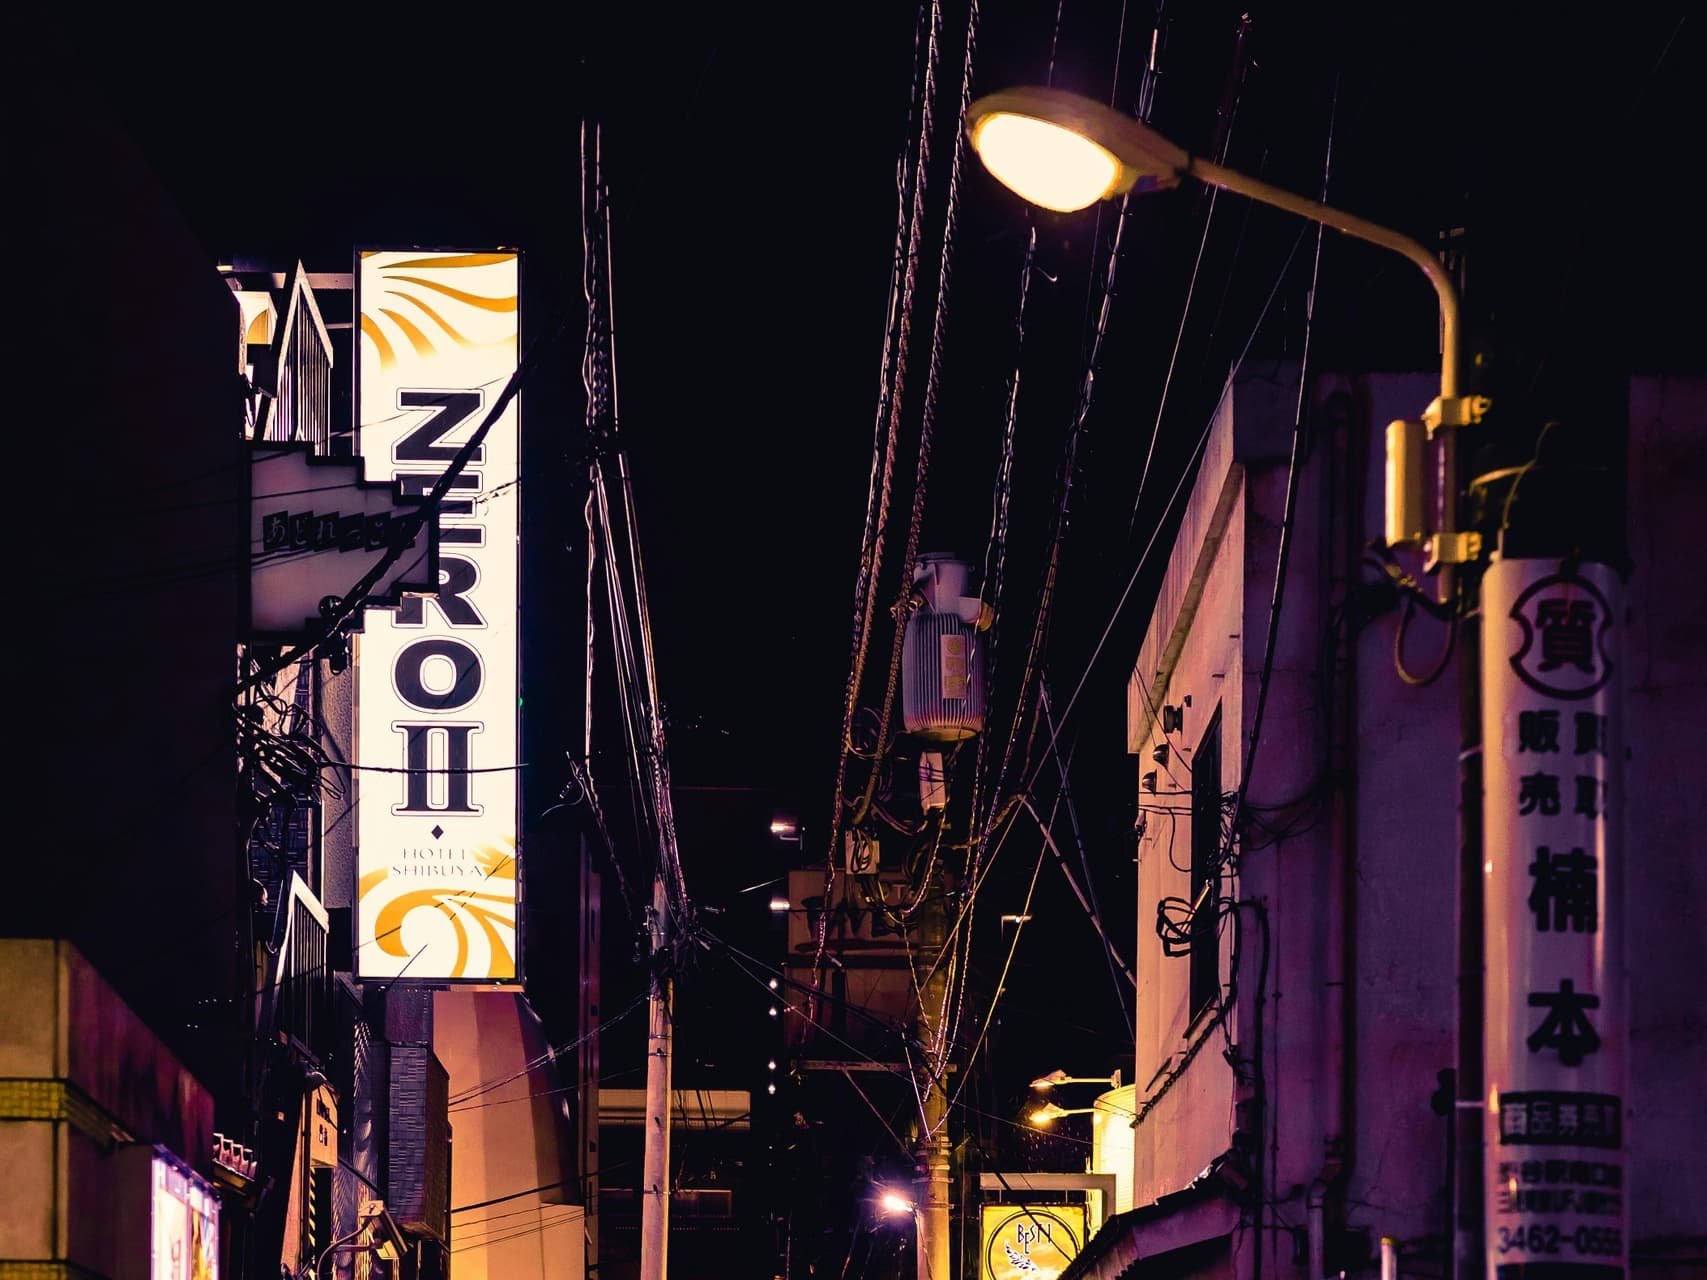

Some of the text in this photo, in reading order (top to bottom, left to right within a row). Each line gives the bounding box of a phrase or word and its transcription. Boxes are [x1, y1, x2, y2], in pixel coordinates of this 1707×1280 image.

[1535, 601, 1597, 674] 質
[1518, 709, 1561, 817] 販売
[392, 865, 483, 877] SHIBUYA
